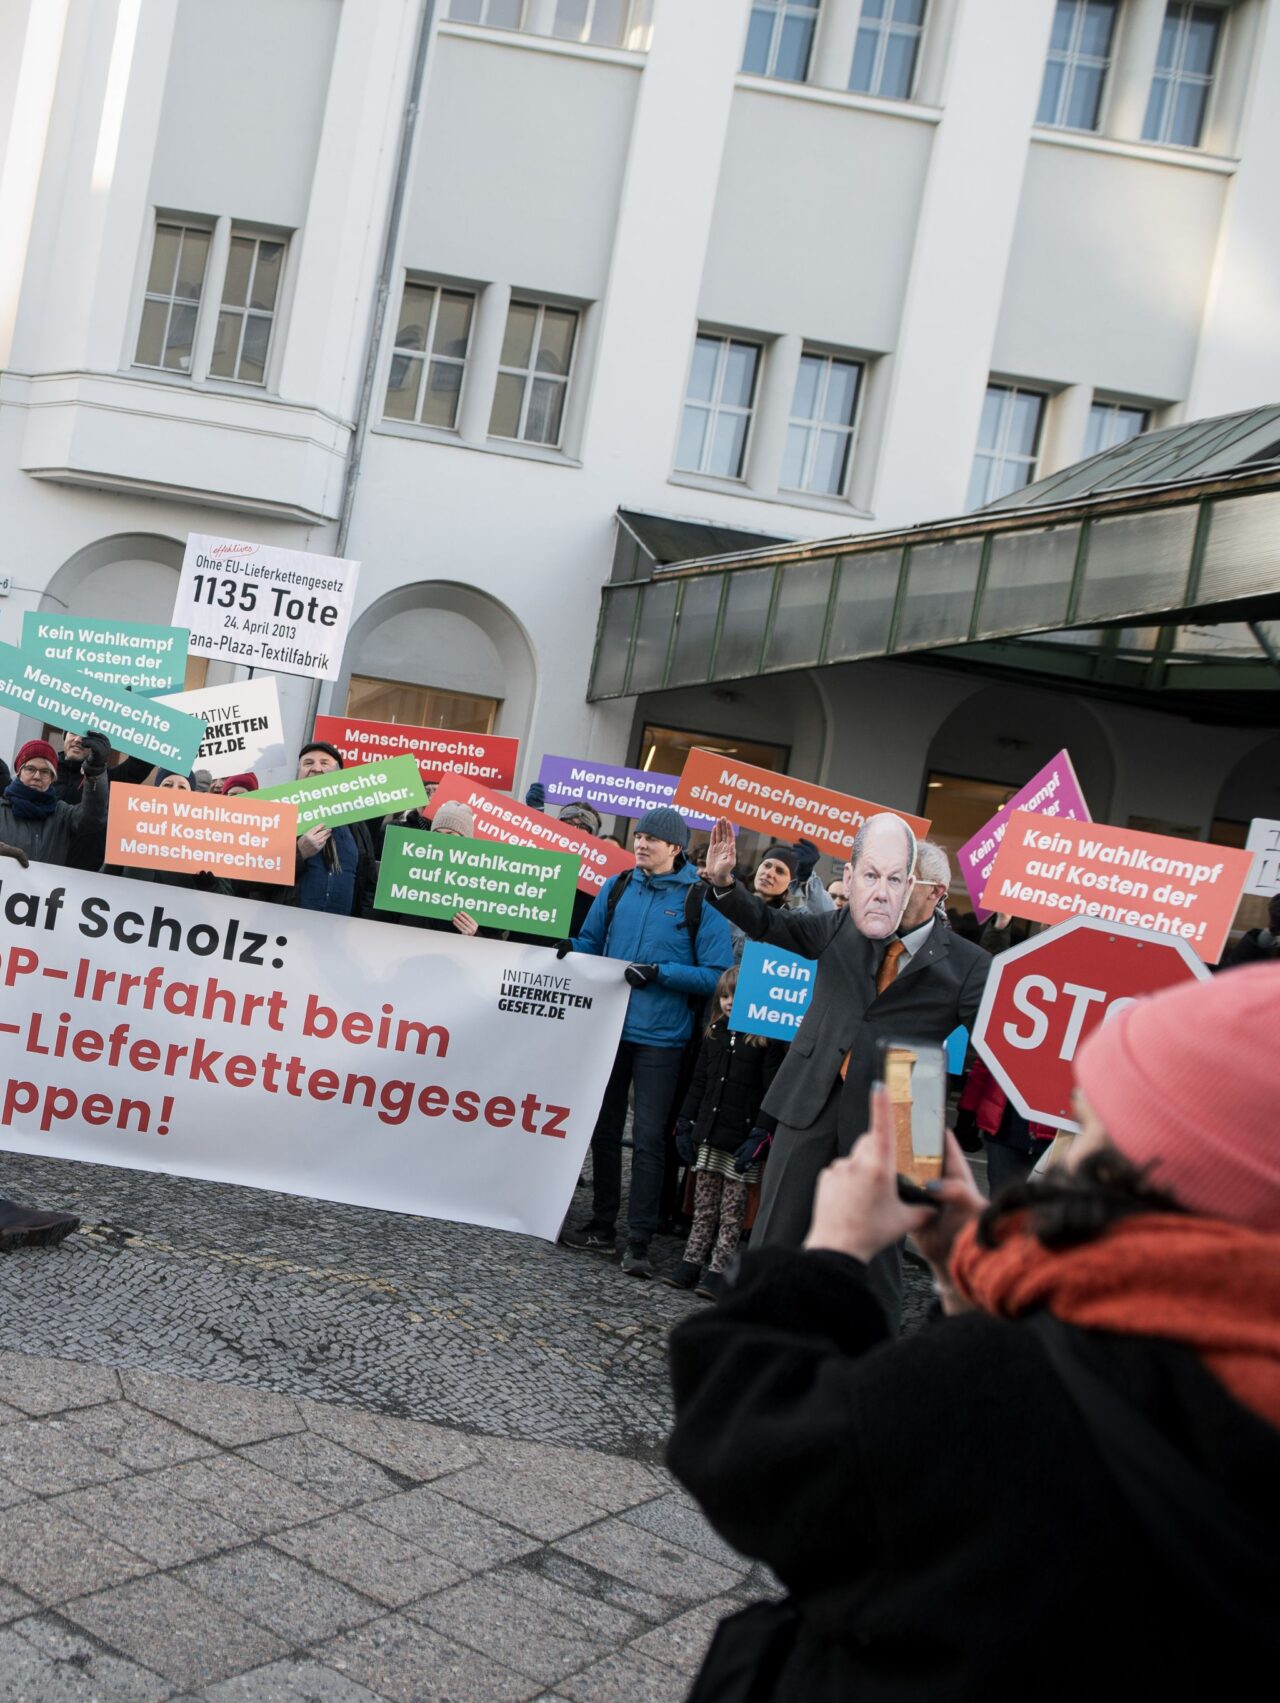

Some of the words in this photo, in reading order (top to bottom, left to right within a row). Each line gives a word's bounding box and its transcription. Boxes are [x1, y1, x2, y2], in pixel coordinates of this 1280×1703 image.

[196, 554, 222, 571] Ohne
[225, 559, 344, 592] EU-Lieferkettengesetz
[193, 574, 259, 612] 1135
[271, 587, 338, 626] Tote
[38, 624, 74, 641] Kein
[78, 629, 174, 654] Wahlkampf
[224, 615, 240, 630] 24.
[242, 618, 269, 636] April
[272, 624, 296, 640] 2013
[45, 646, 73, 660] auf
[76, 648, 133, 666] Kosten
[135, 655, 162, 670] der
[188, 632, 329, 670] ana-Plaza-Textilfabrik
[24, 665, 170, 732] Menschenrechte
[37, 694, 182, 760] unverhandelbar.
[202, 716, 268, 740] RKETTEN
[345, 728, 485, 758] Menschenrechte
[196, 737, 246, 758] ETZ.DE
[548, 782, 584, 798] sind
[571, 768, 677, 796] Menschenre
[720, 770, 865, 828] Menschenrech
[128, 797, 168, 815] Kein
[172, 803, 280, 832] Wahlkampf
[466, 792, 608, 866] Menschenrechte
[690, 784, 732, 808] sind
[734, 800, 855, 848] unverhande
[136, 821, 168, 836] auf
[170, 823, 234, 844] Kosten
[238, 834, 270, 848] der
[120, 838, 281, 871] Menschenrechte!
[402, 841, 444, 862] Kein
[449, 848, 562, 882] Wahlkampf
[970, 838, 995, 866] Kein
[1022, 829, 1072, 855] Kein
[1078, 838, 1224, 886] Wahlkampf
[408, 866, 442, 884] auf
[444, 870, 510, 894] Kosten
[514, 883, 546, 900] der
[1026, 860, 1066, 879] auf
[1066, 866, 1149, 899] Kosten
[1152, 884, 1198, 908] der
[390, 884, 557, 924] Menschenrechte!
[1000, 880, 1208, 941] Menschenrechte!
[78, 896, 289, 969] Scholz:
[503, 969, 572, 990] INITIATIVE
[762, 959, 810, 982] Kein
[498, 999, 566, 1020] GESETZ.DE
[500, 984, 593, 1010] LIEFERKETTEN
[770, 986, 808, 1004] auf
[302, 994, 452, 1060] beim
[1003, 974, 1138, 1062] ST
